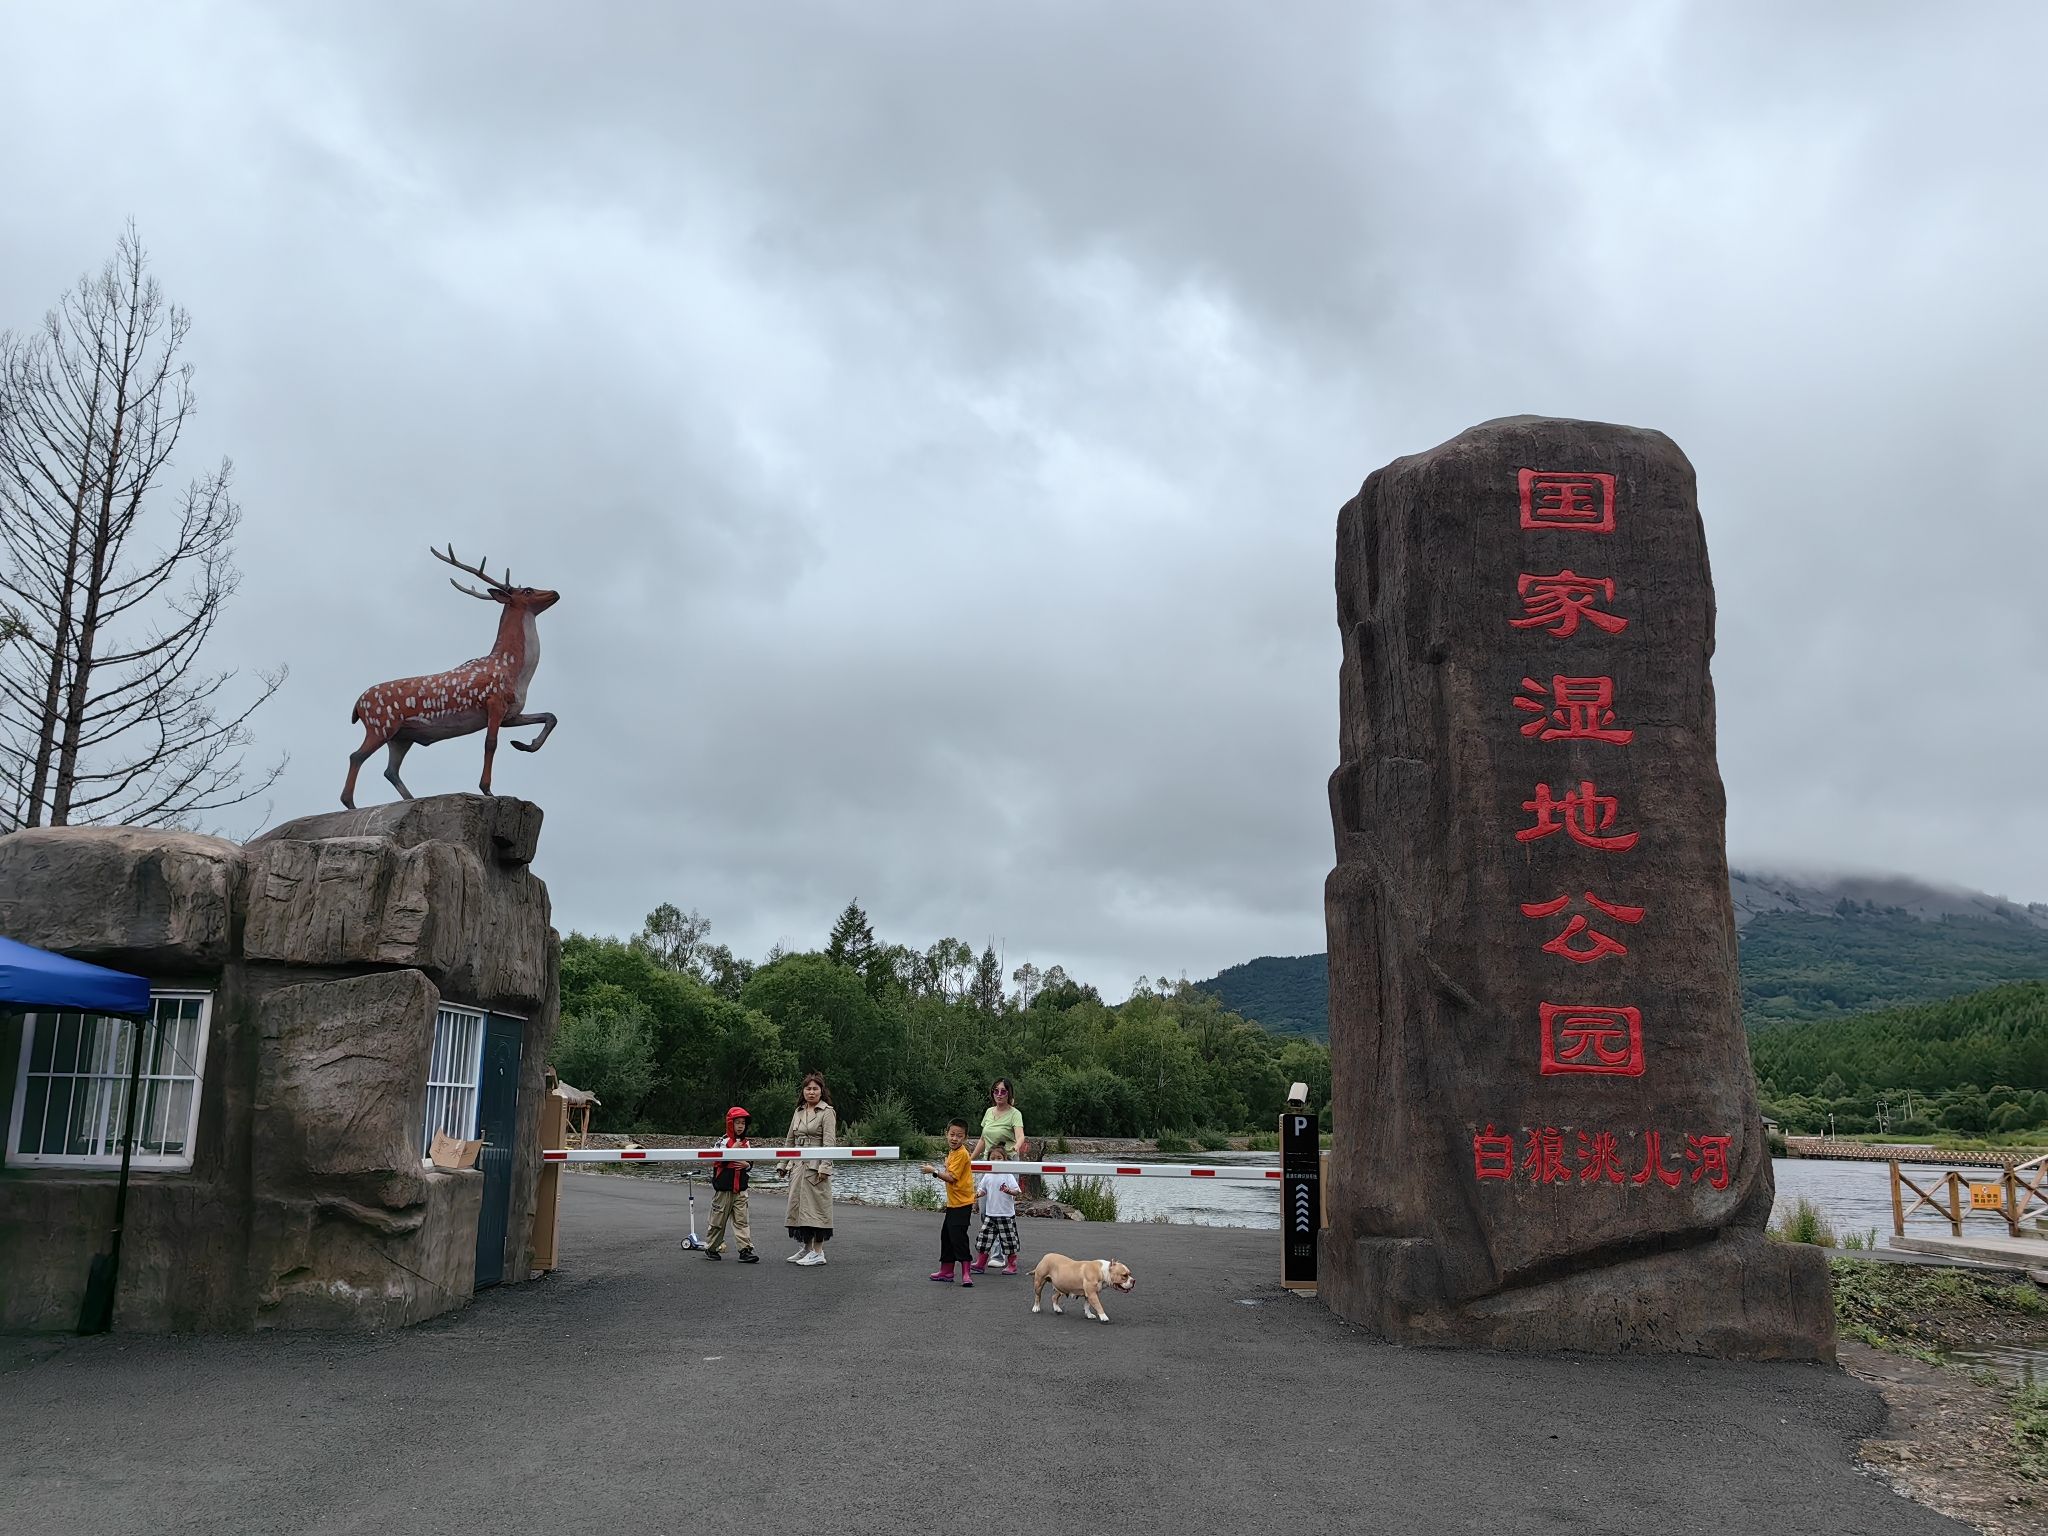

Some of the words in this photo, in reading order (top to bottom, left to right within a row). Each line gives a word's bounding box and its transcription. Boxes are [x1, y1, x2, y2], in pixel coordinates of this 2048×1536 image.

[1508, 467, 1645, 1077] 国家湿地公园
[1294, 1116, 1308, 1136] P
[1473, 1123, 1732, 1189] 白狼洮儿河
